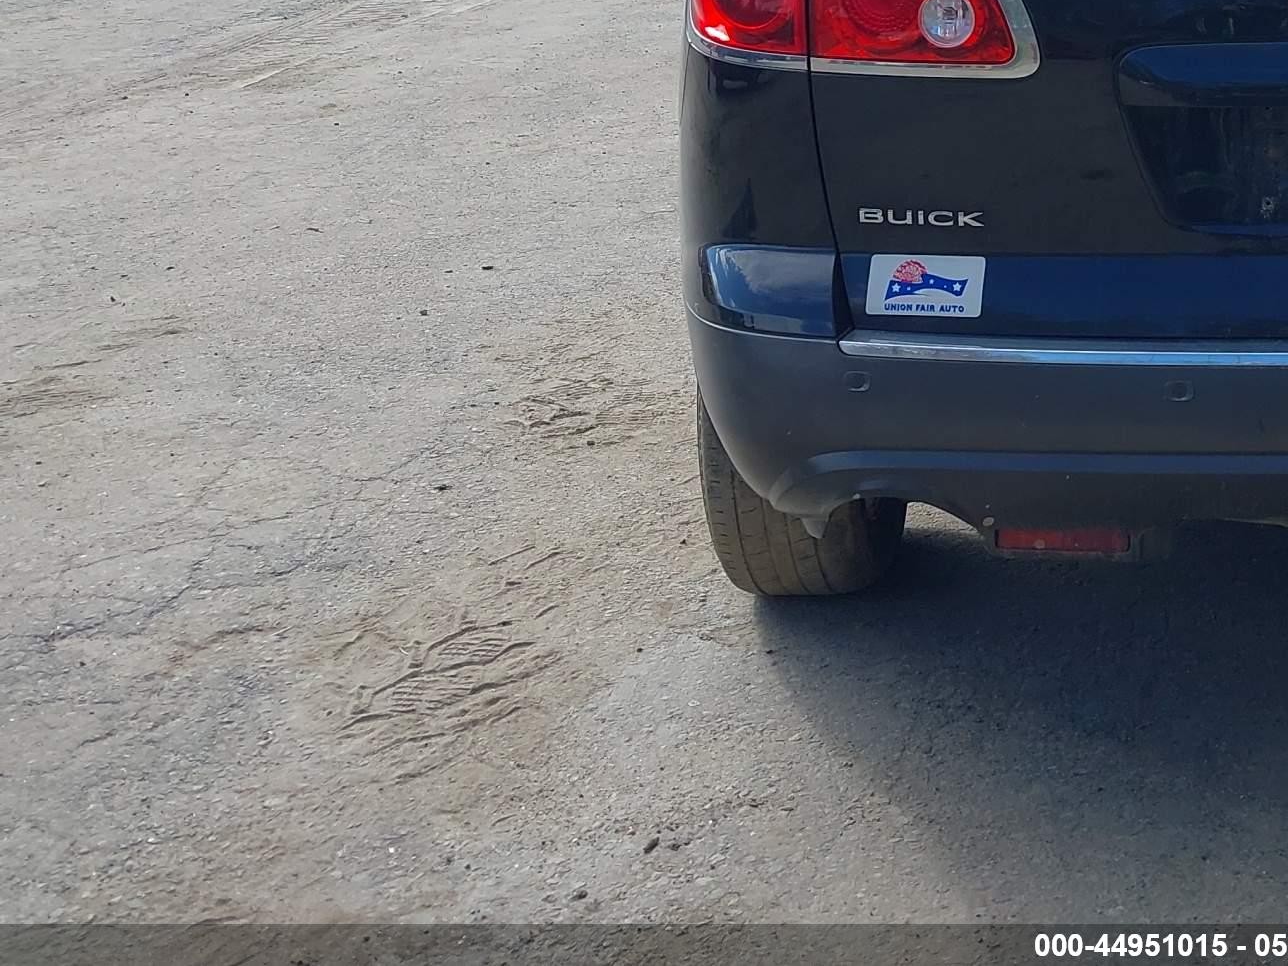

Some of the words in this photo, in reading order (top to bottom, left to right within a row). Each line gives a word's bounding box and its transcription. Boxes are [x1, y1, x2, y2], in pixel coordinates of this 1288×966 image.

[859, 208, 985, 227] BUICK
[884, 303, 913, 311] UNION
[915, 304, 935, 312] FAIR
[939, 305, 965, 313] AUTO
